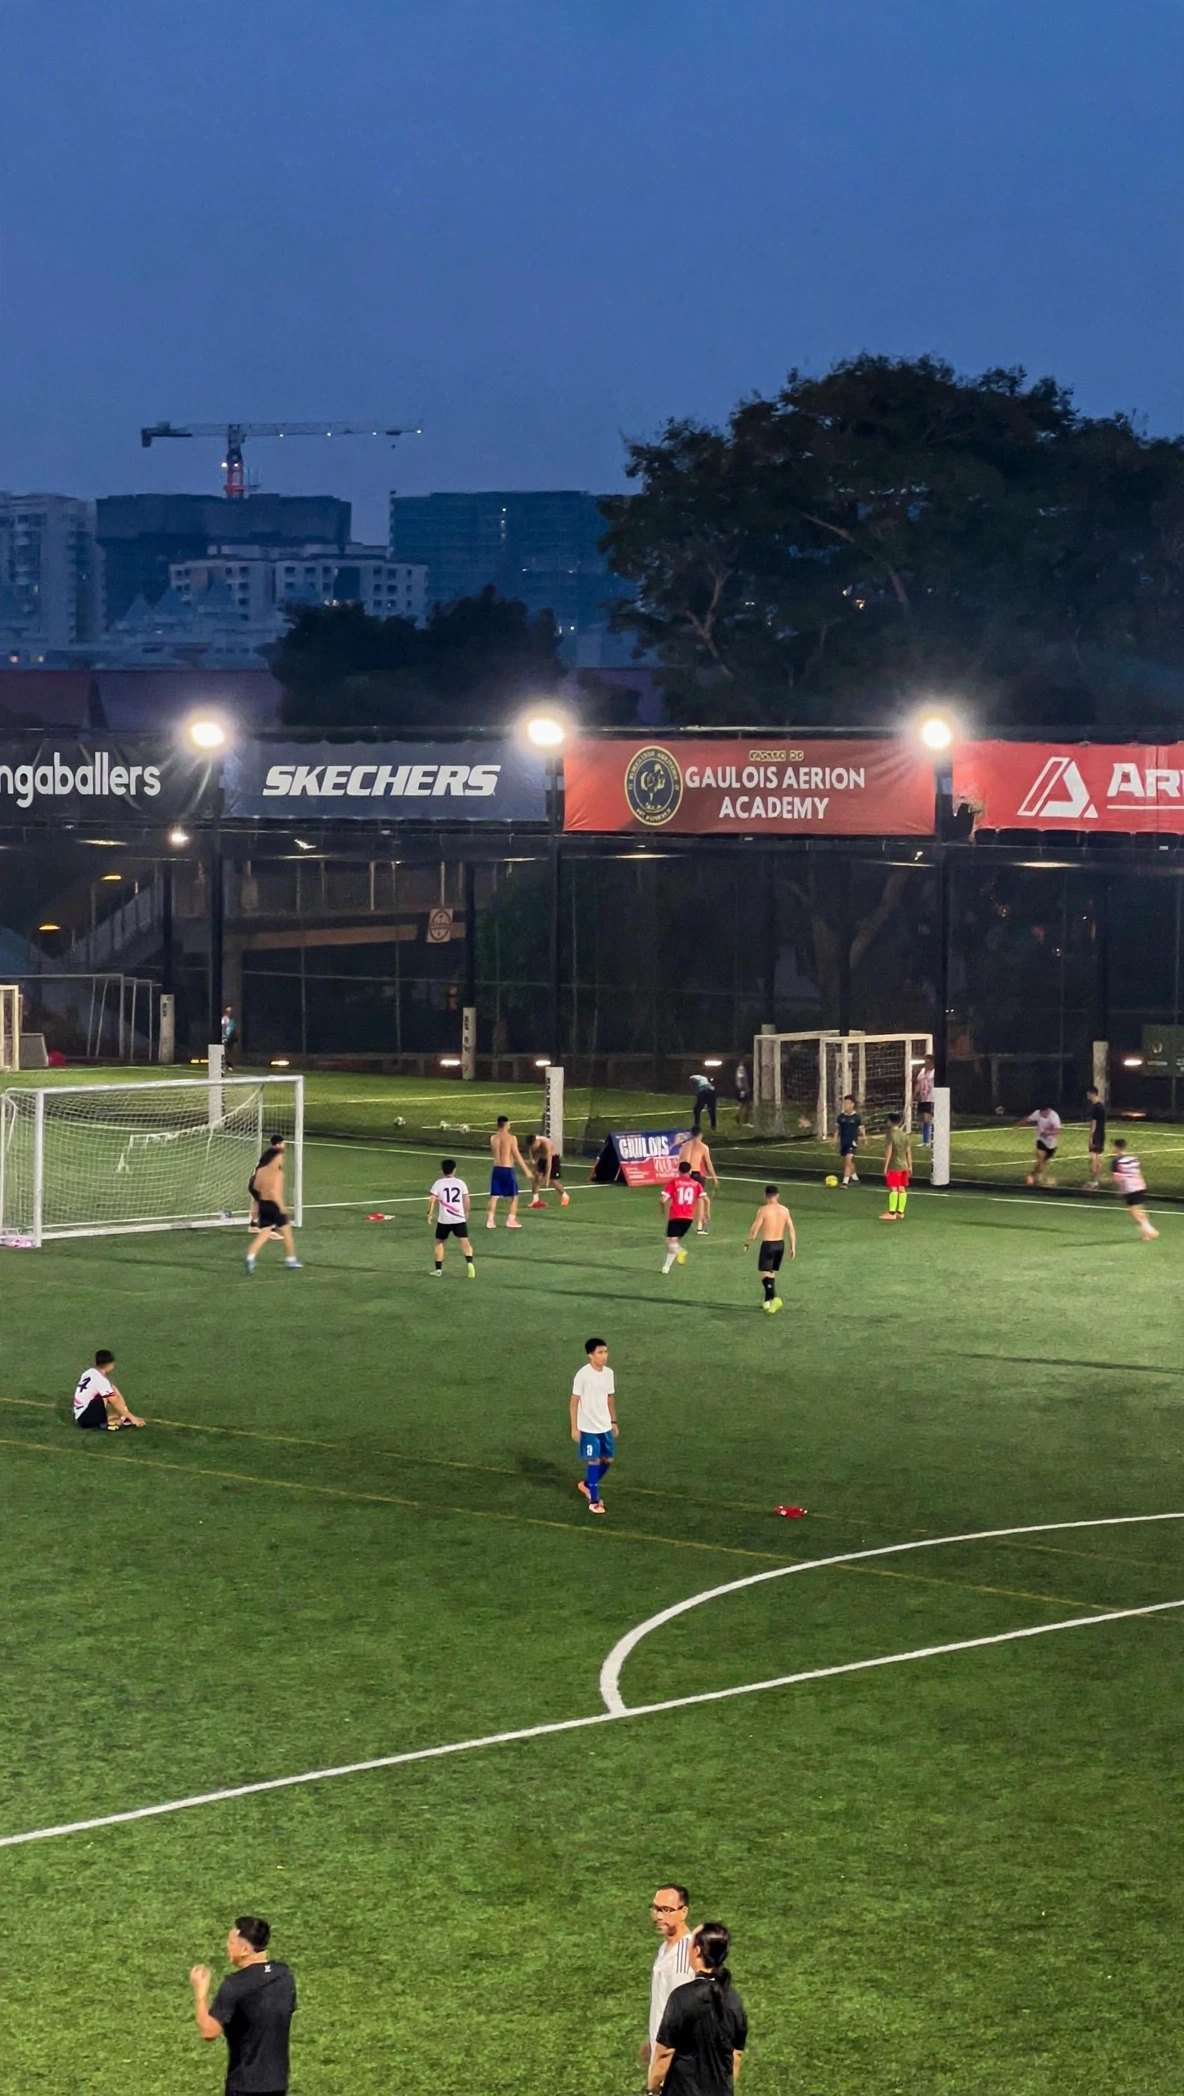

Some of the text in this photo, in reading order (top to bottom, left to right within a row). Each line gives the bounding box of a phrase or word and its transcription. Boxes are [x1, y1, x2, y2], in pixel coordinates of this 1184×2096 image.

[0, 752, 161, 808] ngaballers
[262, 765, 501, 796] SKECHERS
[685, 766, 778, 789] GAULOIS
[782, 767, 865, 790] AERION
[1107, 762, 1184, 798] AR
[719, 796, 829, 819] ACADEMY
[443, 1187, 461, 1203] 12
[77, 1376, 91, 1393] 4
